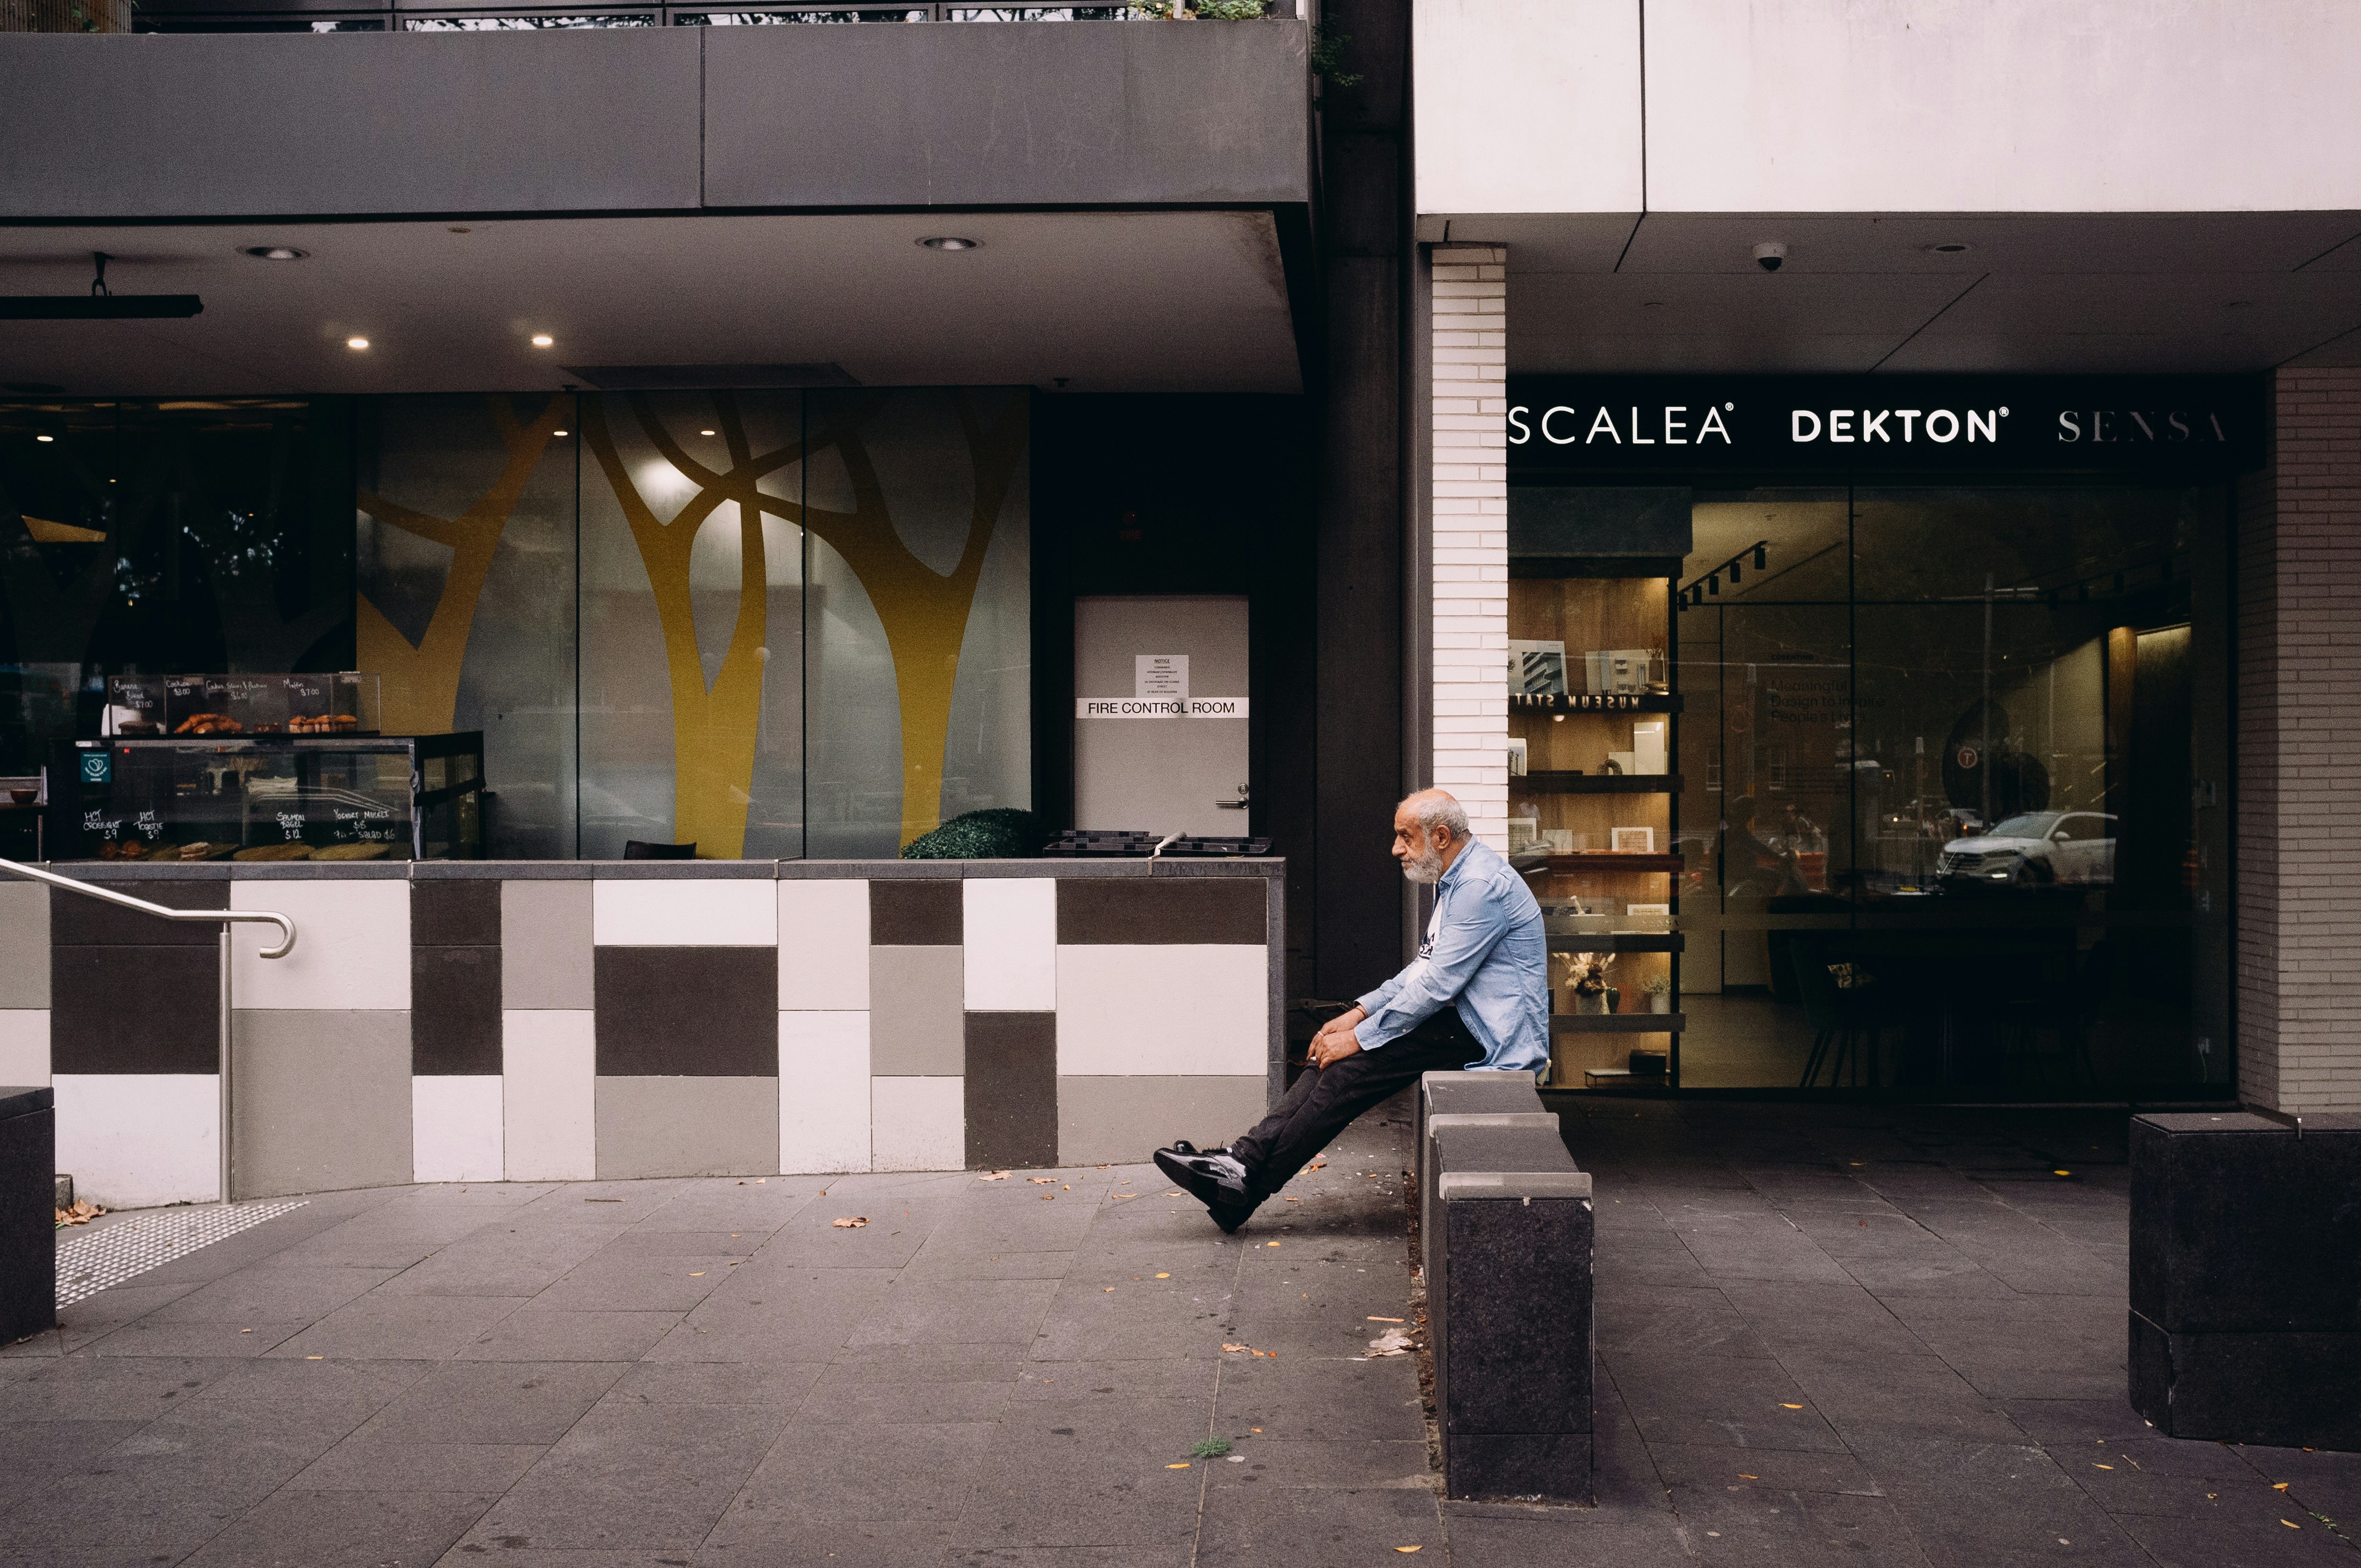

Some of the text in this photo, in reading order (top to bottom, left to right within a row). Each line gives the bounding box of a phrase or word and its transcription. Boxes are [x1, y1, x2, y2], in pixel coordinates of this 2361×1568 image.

[2058, 411, 2226, 443] SENSA
[1771, 680, 1847, 694] Meaningful
[1088, 703, 1235, 714] FIRE CONTROL ROOM
[1771, 695, 1885, 709] Design to Inpire
